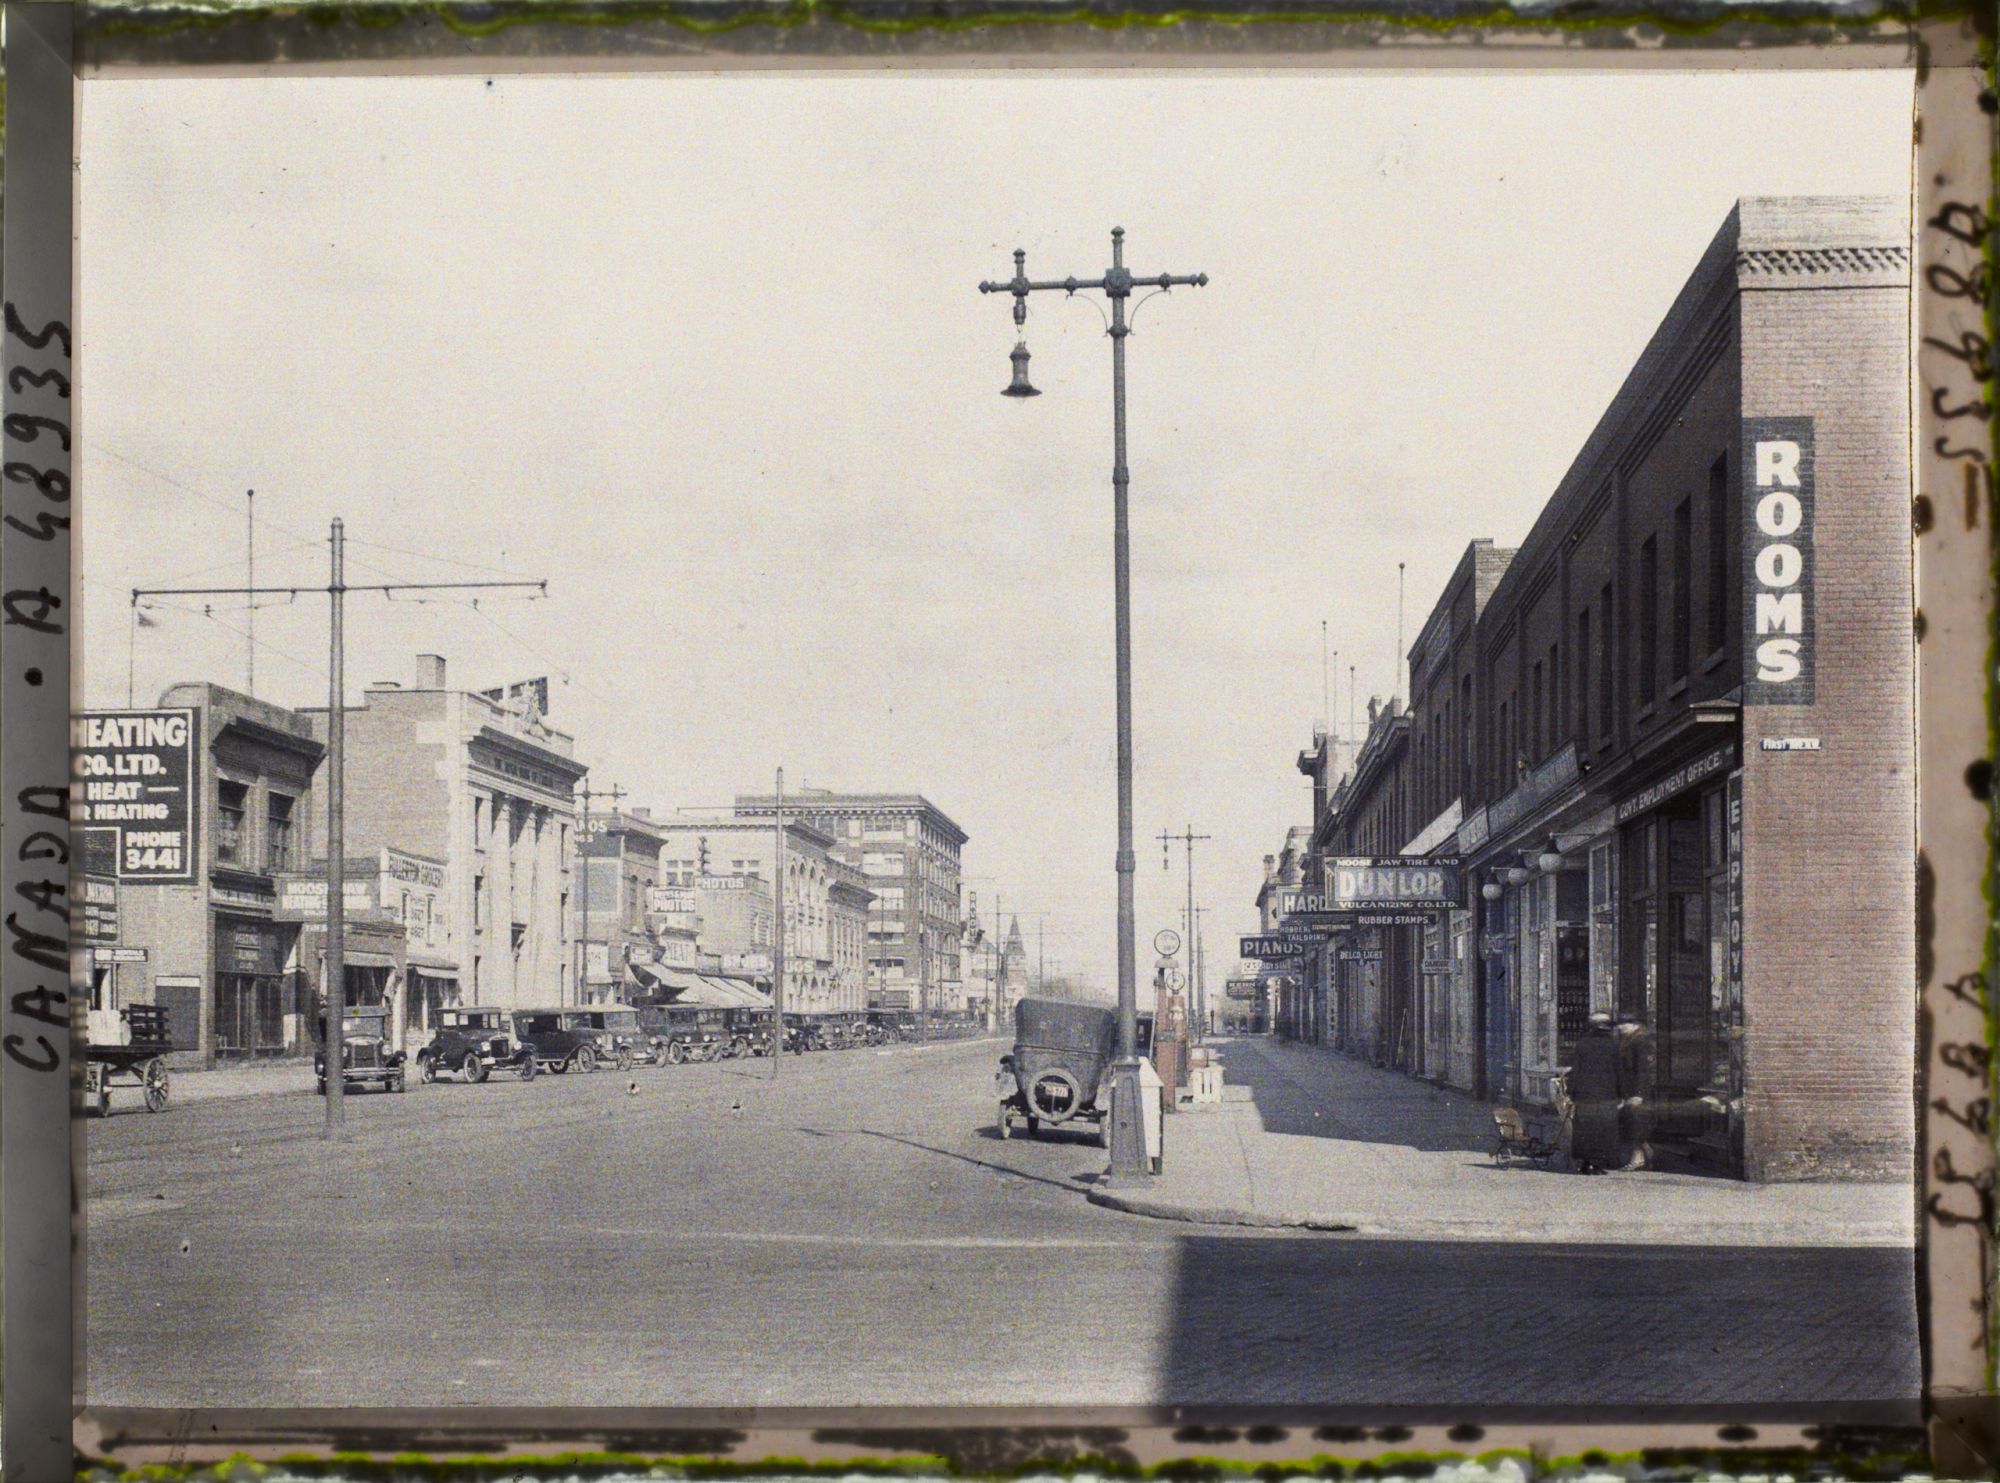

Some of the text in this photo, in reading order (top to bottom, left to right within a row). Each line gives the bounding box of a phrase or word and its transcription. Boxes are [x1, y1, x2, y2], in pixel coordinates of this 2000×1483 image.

[2, 302, 70, 541] 48935
[1755, 441, 1802, 682] ROOMS
[87, 782, 142, 800] HEAT
[1639, 770, 1685, 809] EMPLOYMENT
[94, 803, 169, 819] HEATING
[126, 831, 181, 847] PHONE
[126, 848, 181, 869] 3441
[1337, 858, 1459, 867] MOOSE JAW TIRE AND
[694, 877, 744, 889] PHOTOS
[1339, 870, 1444, 898] DUNLOP
[654, 899, 695, 912] PHOTOS
[1338, 900, 1413, 909] VULCANIZING
[1358, 915, 1393, 925] RUBBER
[3, 785, 70, 1073] CANADA
[1288, 933, 1325, 942] TAILORING
[1243, 940, 1303, 955] PIANOS
